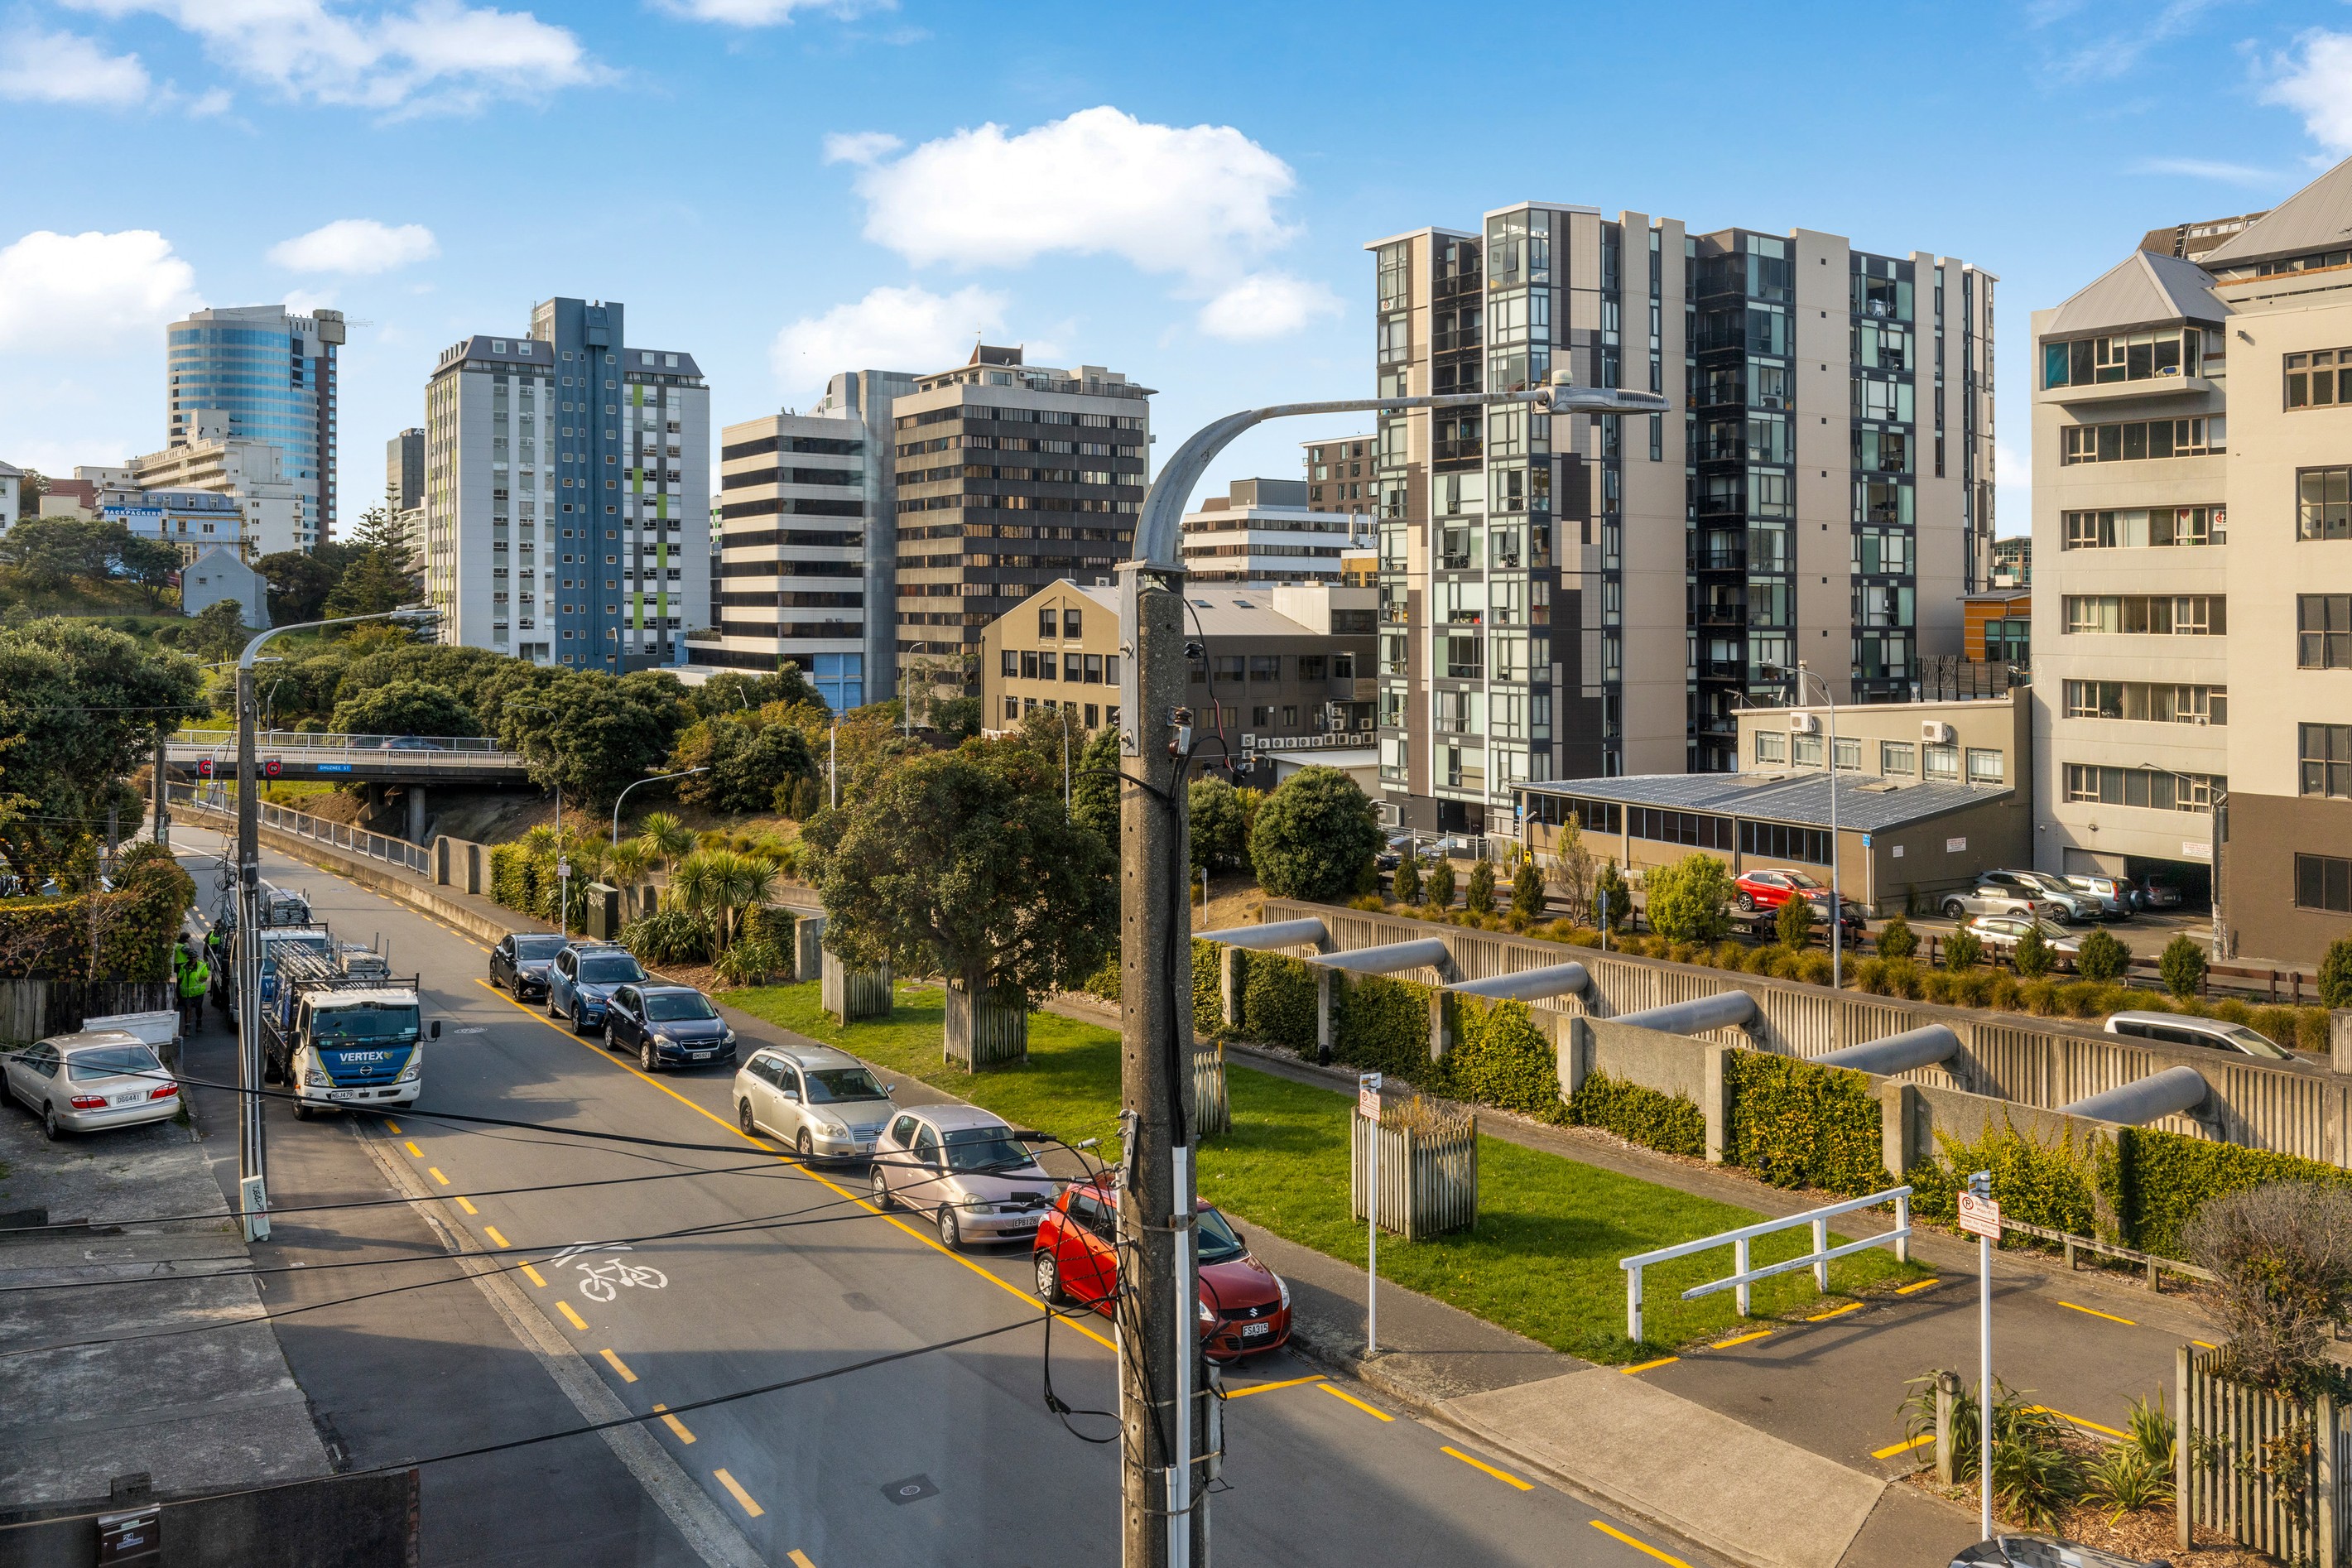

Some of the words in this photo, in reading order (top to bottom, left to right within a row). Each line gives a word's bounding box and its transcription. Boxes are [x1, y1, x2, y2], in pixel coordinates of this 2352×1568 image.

[339, 1051, 383, 1061] VERTEX
[118, 1094, 140, 1103] DGG441
[1014, 1217, 1037, 1227] EPB128
[1243, 1323, 1268, 1335] FSA315
[123, 1533, 132, 1542] 24
